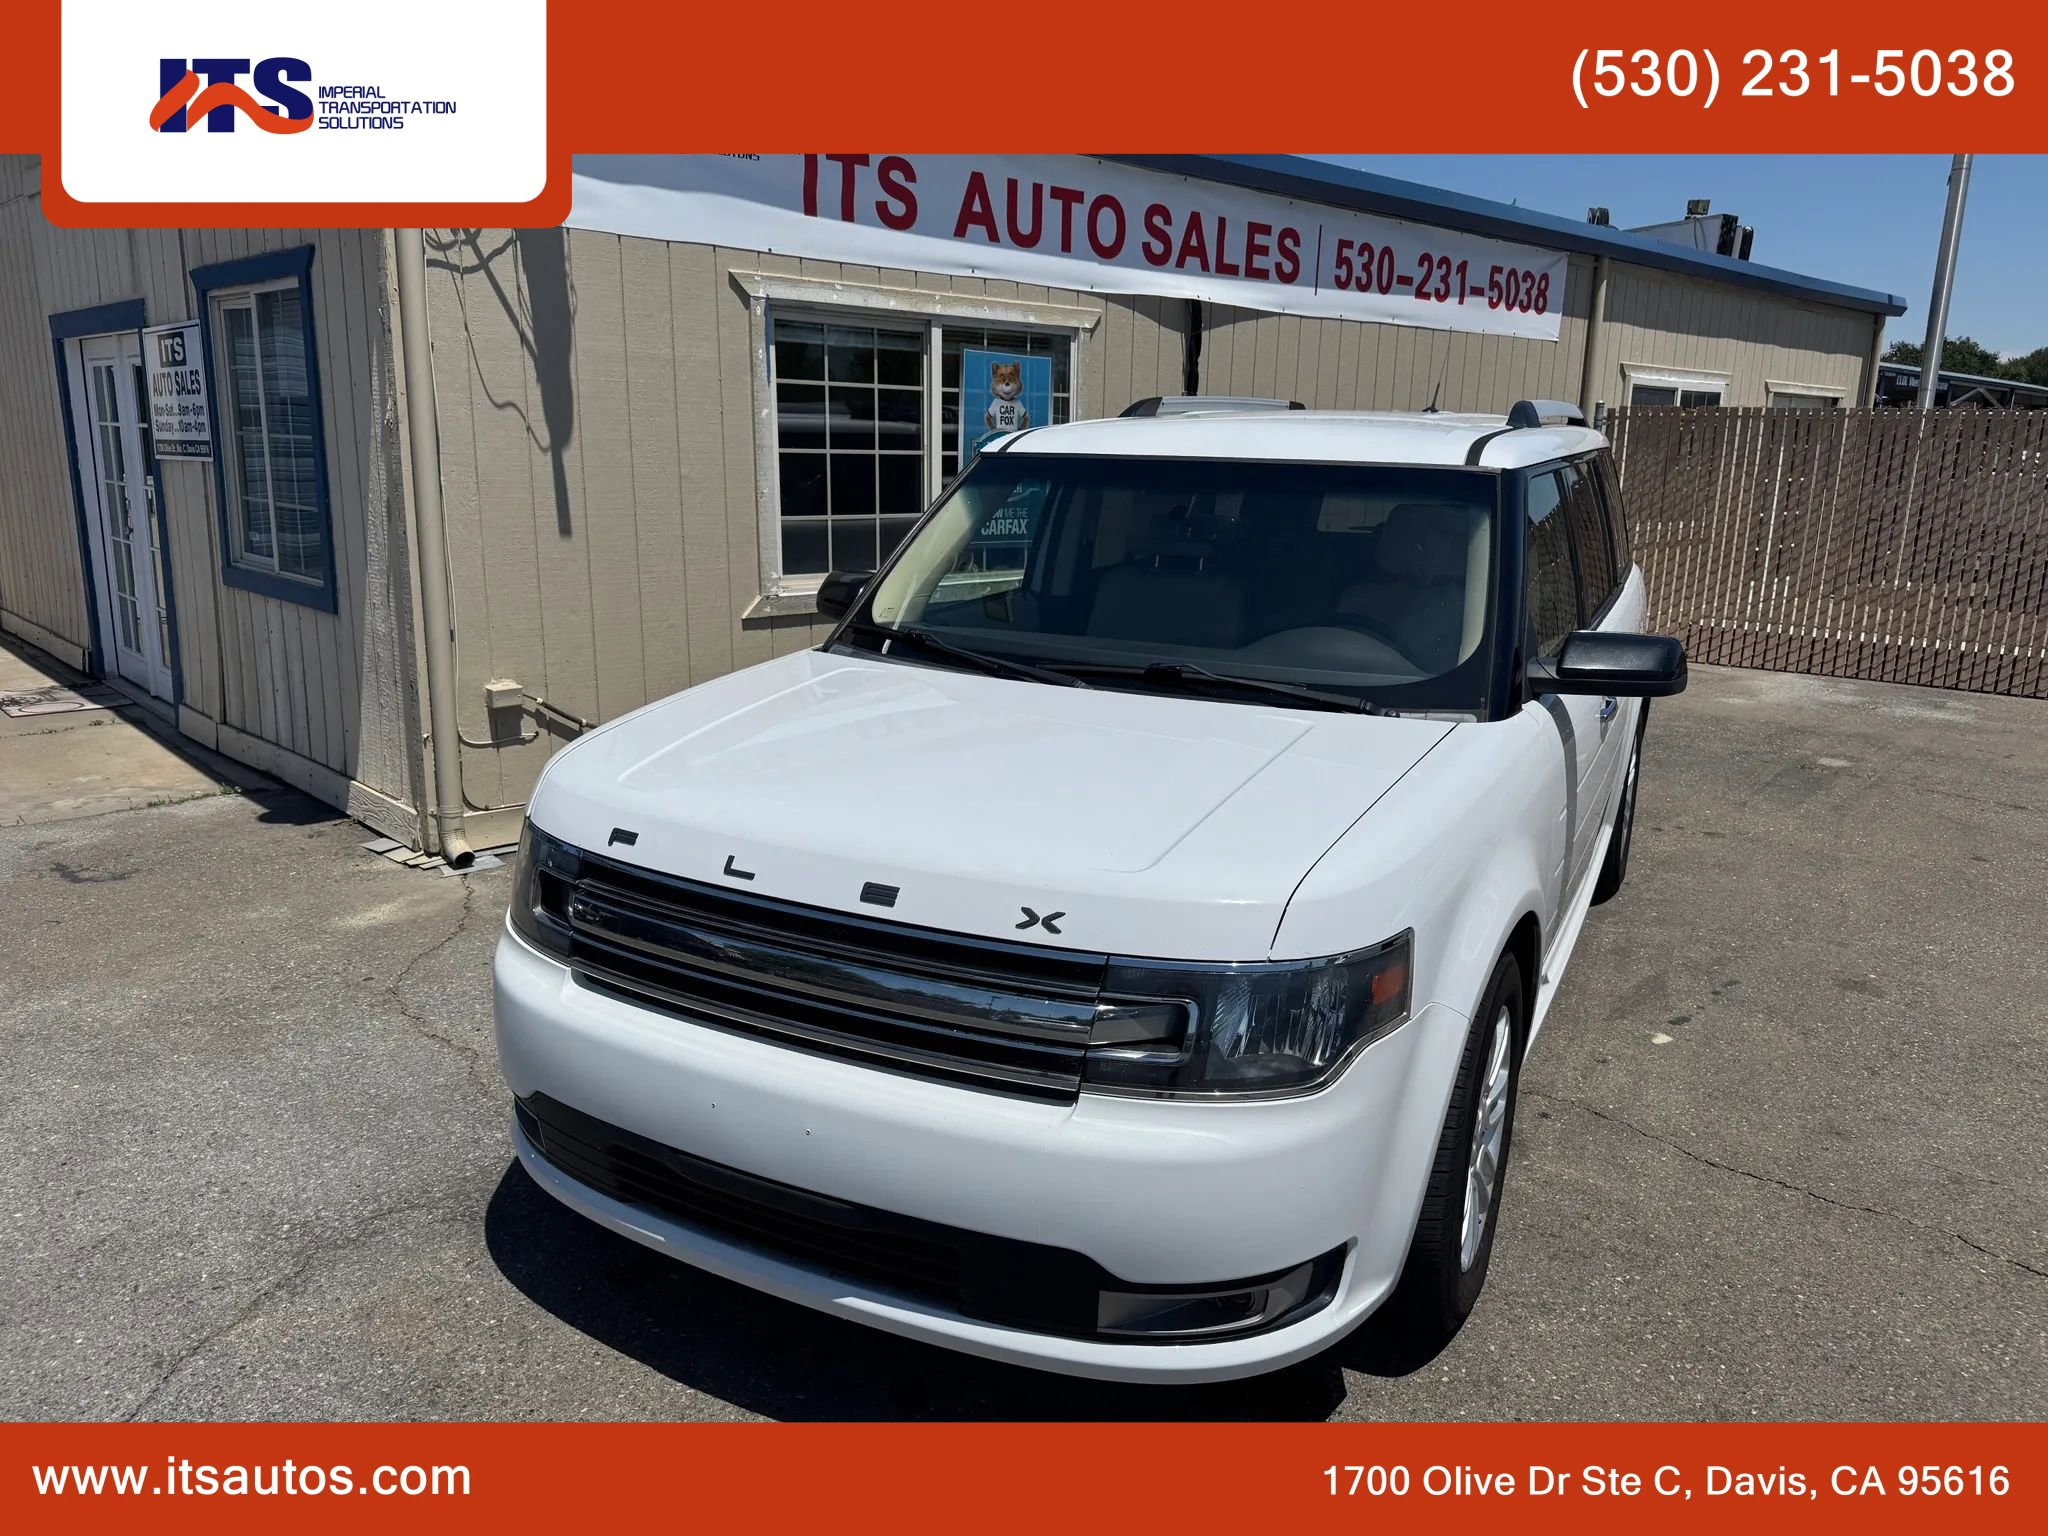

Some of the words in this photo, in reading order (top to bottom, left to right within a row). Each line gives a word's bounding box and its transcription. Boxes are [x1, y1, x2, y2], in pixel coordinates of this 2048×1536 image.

[803, 154, 918, 231] ITS
[952, 170, 1127, 260] AUTO
[1141, 203, 1301, 284] SALES
[1334, 238, 1550, 316] 530-231-5038
[160, 337, 184, 363] ITS
[152, 371, 173, 397] AUTO
[175, 368, 201, 396] SALES
[999, 405, 1015, 415] CAR
[999, 415, 1015, 426] FOX
[607, 827, 1066, 935] FLEX
